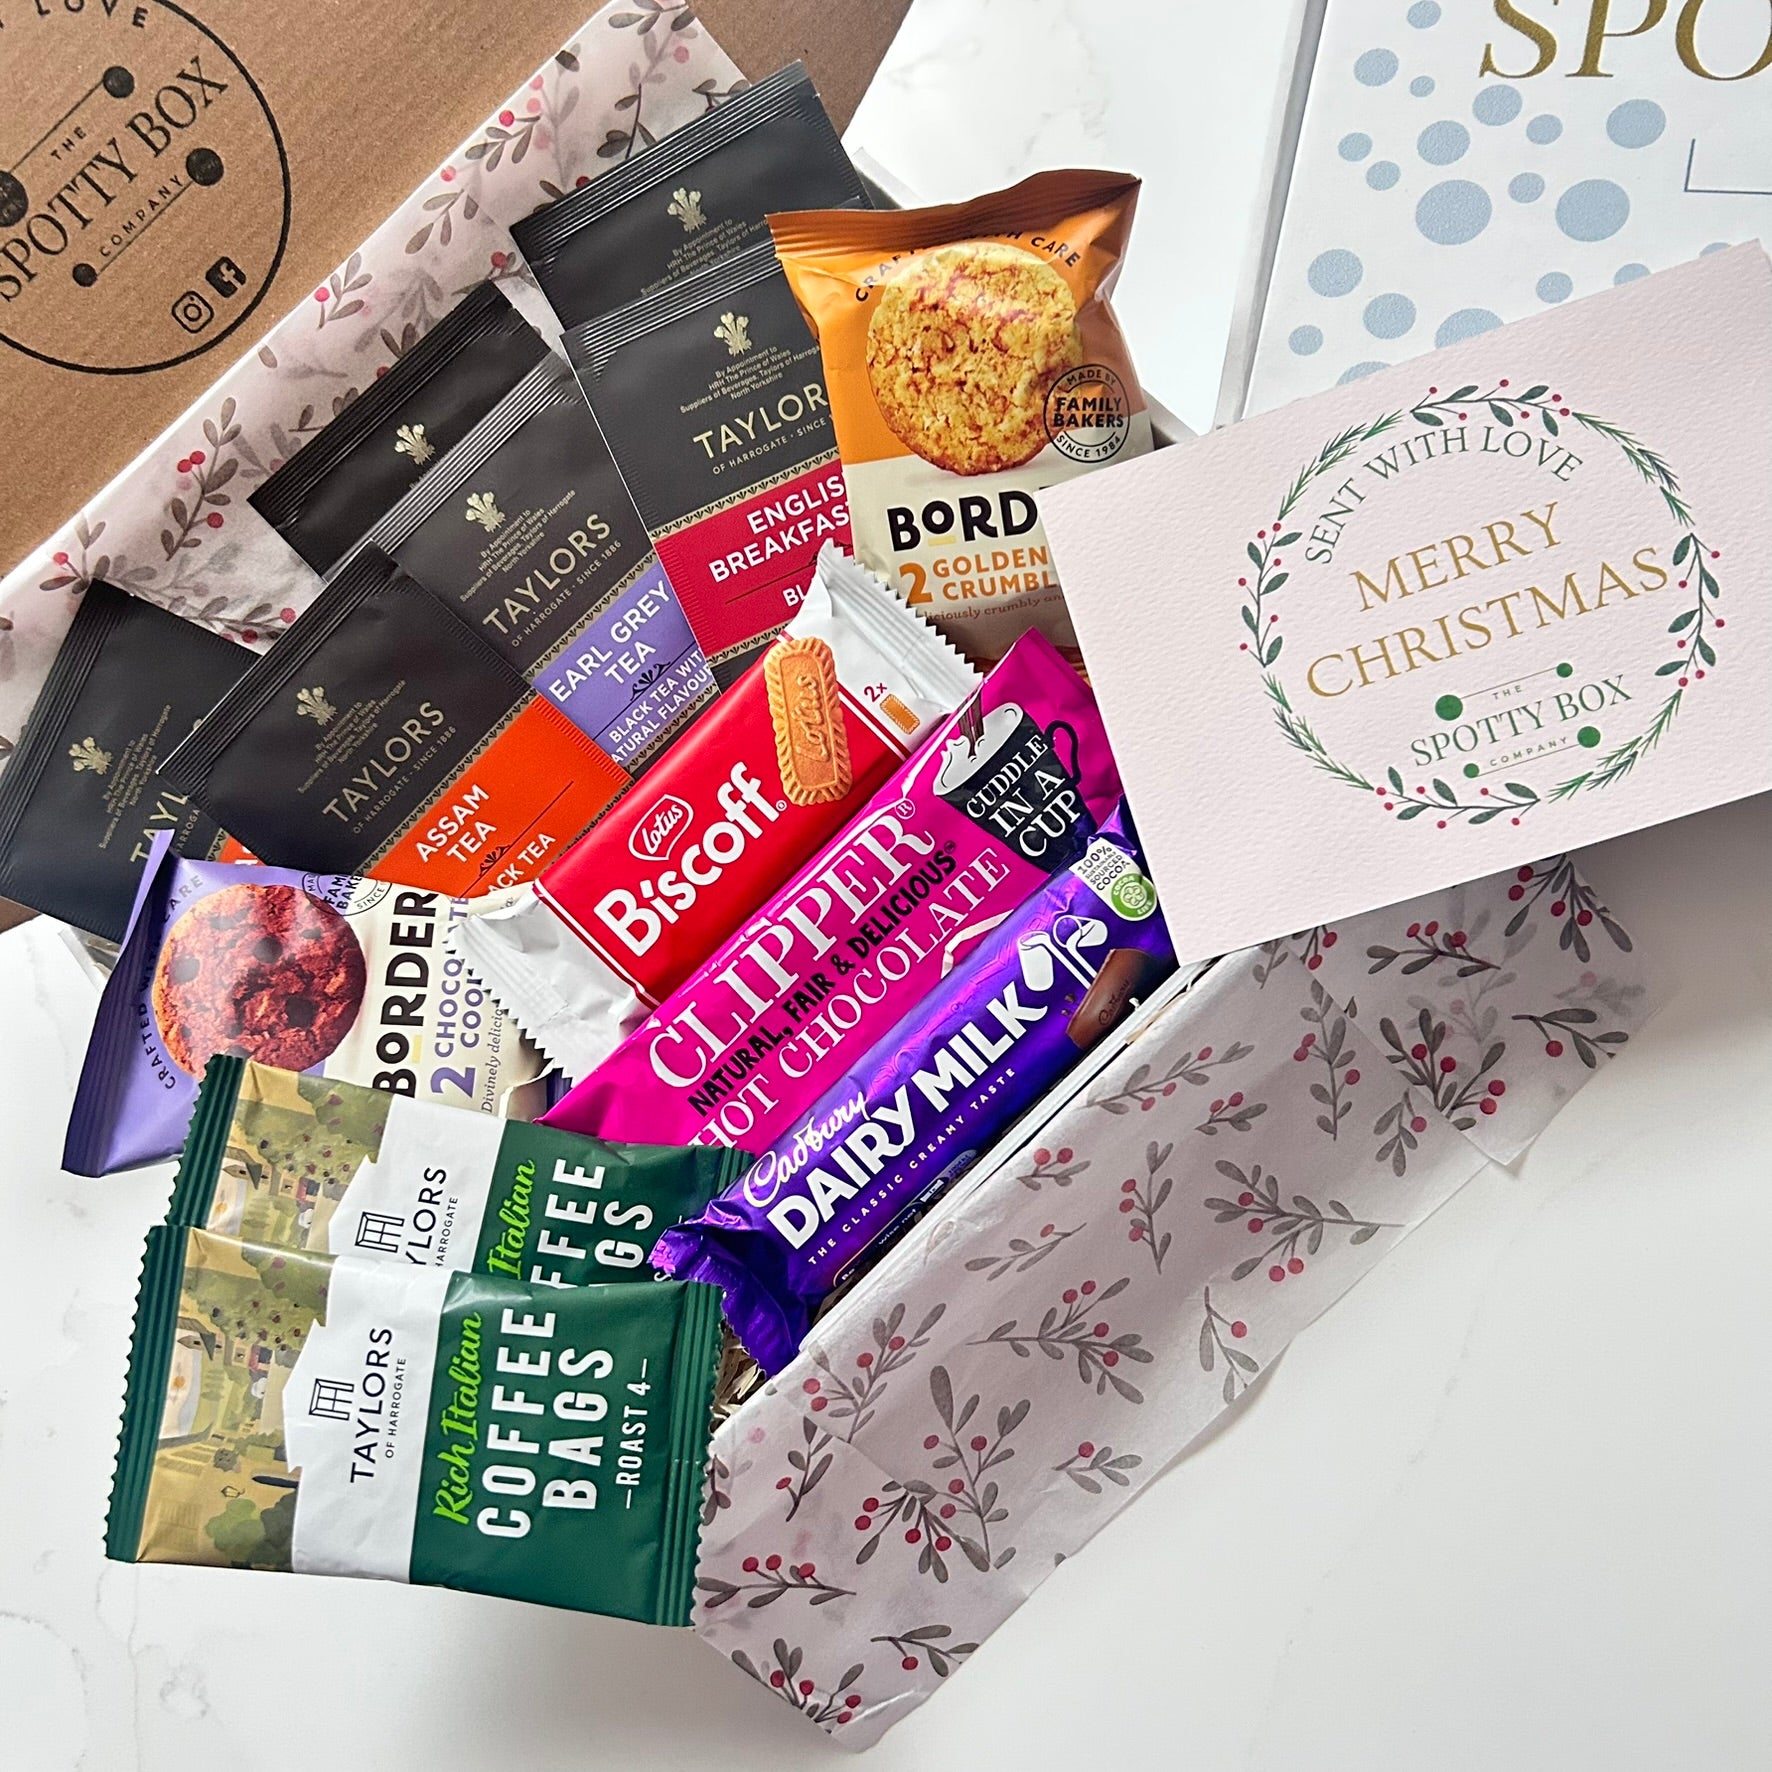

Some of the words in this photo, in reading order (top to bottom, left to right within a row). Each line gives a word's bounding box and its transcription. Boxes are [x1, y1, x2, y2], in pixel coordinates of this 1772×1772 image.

[51, 126, 87, 160] THE
[125, 56, 229, 158] BOX
[100, 174, 183, 257] COMPANY
[1030, 236, 1081, 267] CARE
[1055, 396, 1122, 412] FAMILY
[1067, 370, 1101, 386] MADE
[1104, 372, 1116, 385] BY
[712, 464, 726, 475] OF
[729, 436, 788, 467] HARROGATE
[797, 417, 827, 437] SINCE
[1053, 413, 1124, 428] BAKERS
[1056, 434, 1091, 458] SINCE
[1095, 436, 1122, 457] 1984
[887, 489, 1041, 552] BORD
[1305, 477, 1366, 564] SENT
[1363, 426, 1468, 480] WITH
[1480, 426, 1583, 482] LOVE
[482, 514, 611, 634] TAYLORS
[708, 504, 849, 582] BREAKFAS
[899, 562, 933, 605] 2
[933, 545, 1048, 578] GOLDEN
[1349, 501, 1561, 612] MERRY
[512, 635, 523, 648] OF
[524, 589, 572, 636] HARROGATE
[577, 560, 602, 585] SINCE
[602, 541, 622, 560] 1886
[923, 606, 980, 622] liciously
[985, 598, 1040, 616] crumbly
[1306, 547, 1668, 698] CHRISTMAS
[549, 645, 613, 702] EARL
[610, 580, 670, 643] GREY
[604, 641, 656, 684] TEA
[609, 700, 653, 743] BLACK
[650, 677, 679, 705] TEA
[675, 650, 702, 678] WIT
[1410, 700, 1545, 767] SPOTTY
[1553, 674, 1632, 721] BOX
[1492, 685, 1522, 700] THE
[322, 702, 444, 822] TAYLORS
[353, 821, 365, 834] OF
[365, 775, 410, 822] HARROGATE
[413, 745, 437, 771] SINCE
[437, 726, 456, 746] 1886
[966, 735, 1048, 818] CUDDLE
[1489, 737, 1567, 767] COMPANY
[416, 784, 490, 863] ASSAM
[446, 821, 497, 863] TEA
[642, 803, 683, 855] Lotus
[989, 788, 1034, 838] IN
[1034, 770, 1065, 800] A
[1019, 790, 1081, 857] CUP
[517, 833, 556, 865] TEA
[1077, 846, 1112, 875] 100%
[1090, 855, 1123, 885] SOURCED
[1096, 860, 1131, 890] COCOA
[357, 888, 385, 909] SINCE
[372, 892, 439, 1098] BORDER
[685, 1074, 779, 1149] HOT
[778, 848, 1011, 1078] CHOCOLATE
[782, 972, 836, 1023] FAIR
[830, 955, 856, 976] &
[141, 1006, 176, 1089] CRAFTED
[431, 1067, 476, 1098] 2
[481, 1055, 502, 1113] Divinely
[743, 1091, 872, 1207] Cadbury
[766, 1084, 915, 1249] DAIRY
[911, 981, 1048, 1112] MILK
[808, 1238, 836, 1265] THE
[842, 1174, 903, 1233] CLASSIC
[909, 1115, 965, 1169] CREAMY
[970, 1067, 1015, 1110] TASTE
[487, 1159, 536, 1280] Italian
[350, 1328, 394, 1484] TAYLORS
[386, 1357, 407, 1431] HARROGATE
[441, 1312, 482, 1441] Italian
[384, 1440, 395, 1458] OF
[477, 1307, 557, 1538] COFFEE
[542, 1348, 614, 1510] BAGS
[616, 1406, 648, 1486] ROAST
[432, 1443, 477, 1525] Rich
